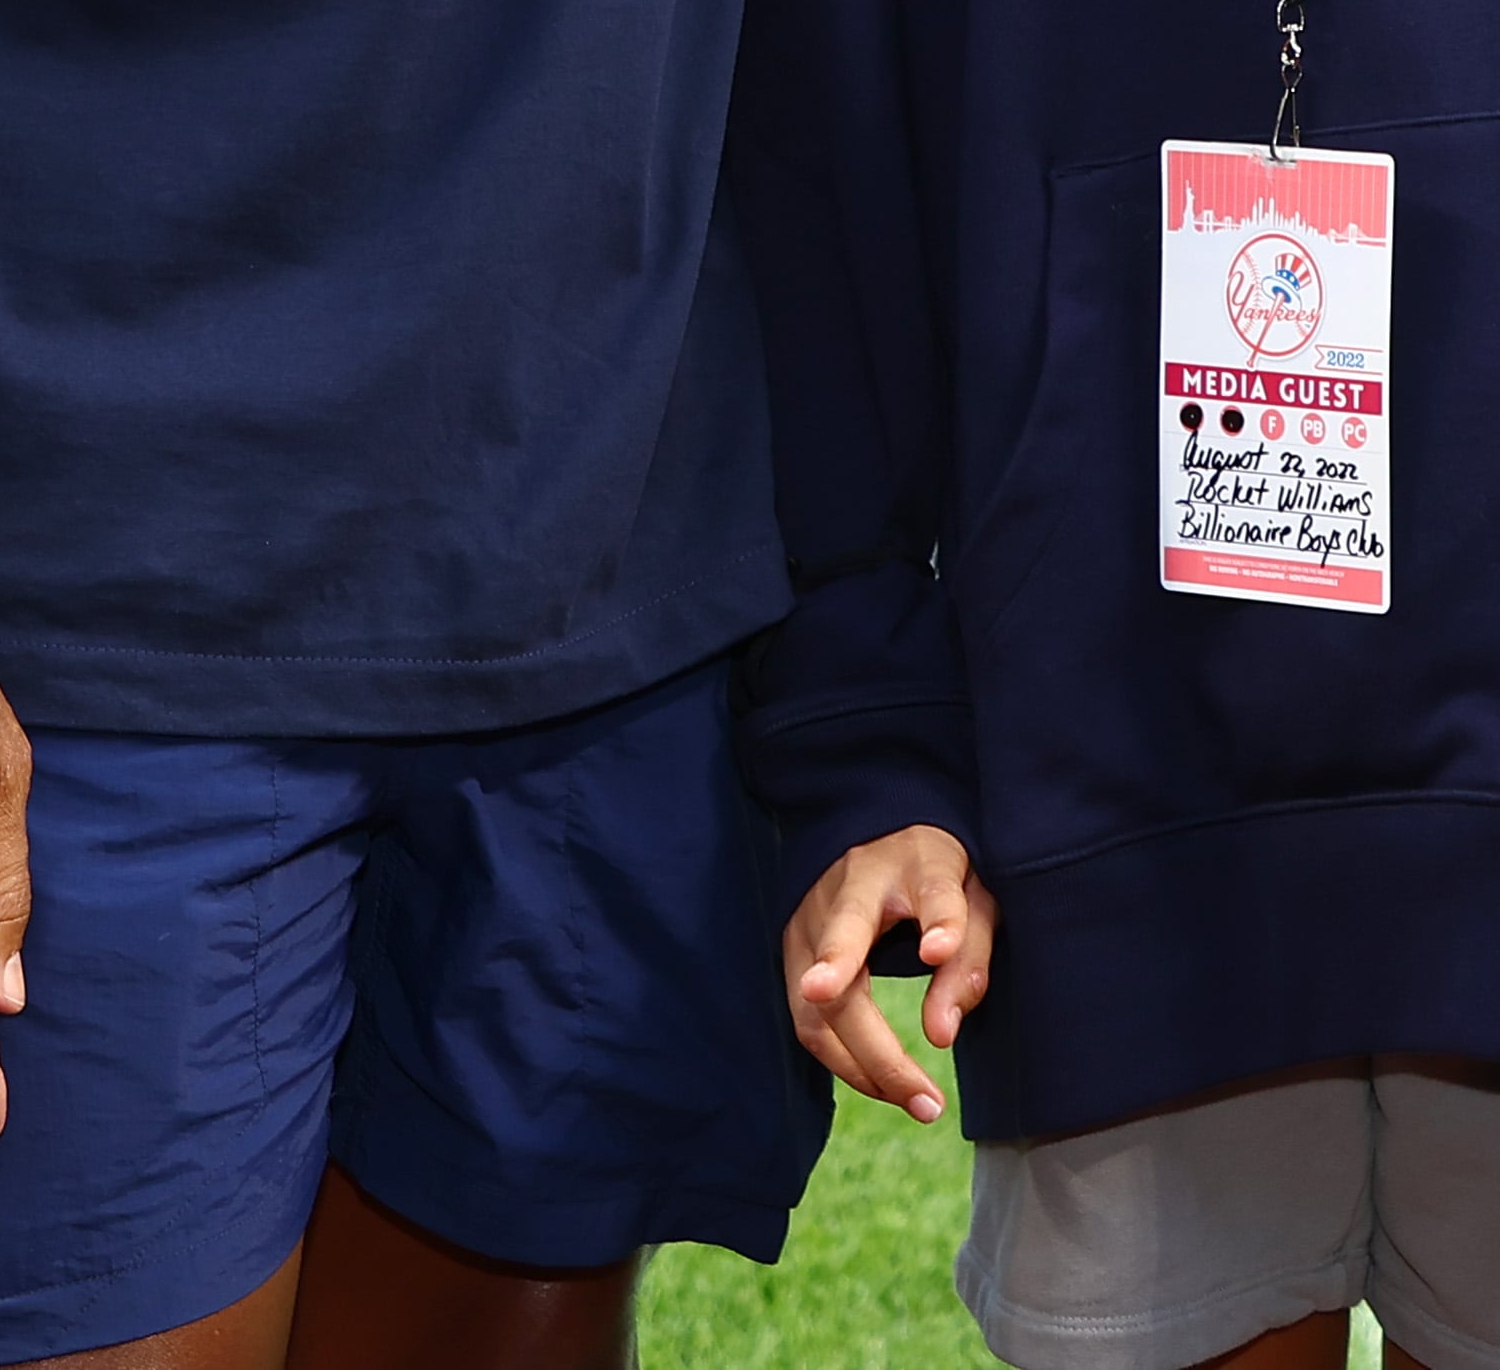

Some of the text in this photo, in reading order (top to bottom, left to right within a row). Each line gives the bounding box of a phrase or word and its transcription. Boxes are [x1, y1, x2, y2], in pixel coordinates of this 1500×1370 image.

[1228, 270, 1319, 323] Yankees
[1327, 350, 1365, 368] 2022
[1182, 368, 1364, 409] MEDIA GUEST
[1268, 416, 1365, 442] F PB PC
[1183, 432, 1269, 484] August
[1187, 471, 1373, 516] Rocket Williams
[1175, 500, 1291, 544] Billionaire
[1297, 514, 1341, 568] Boys
